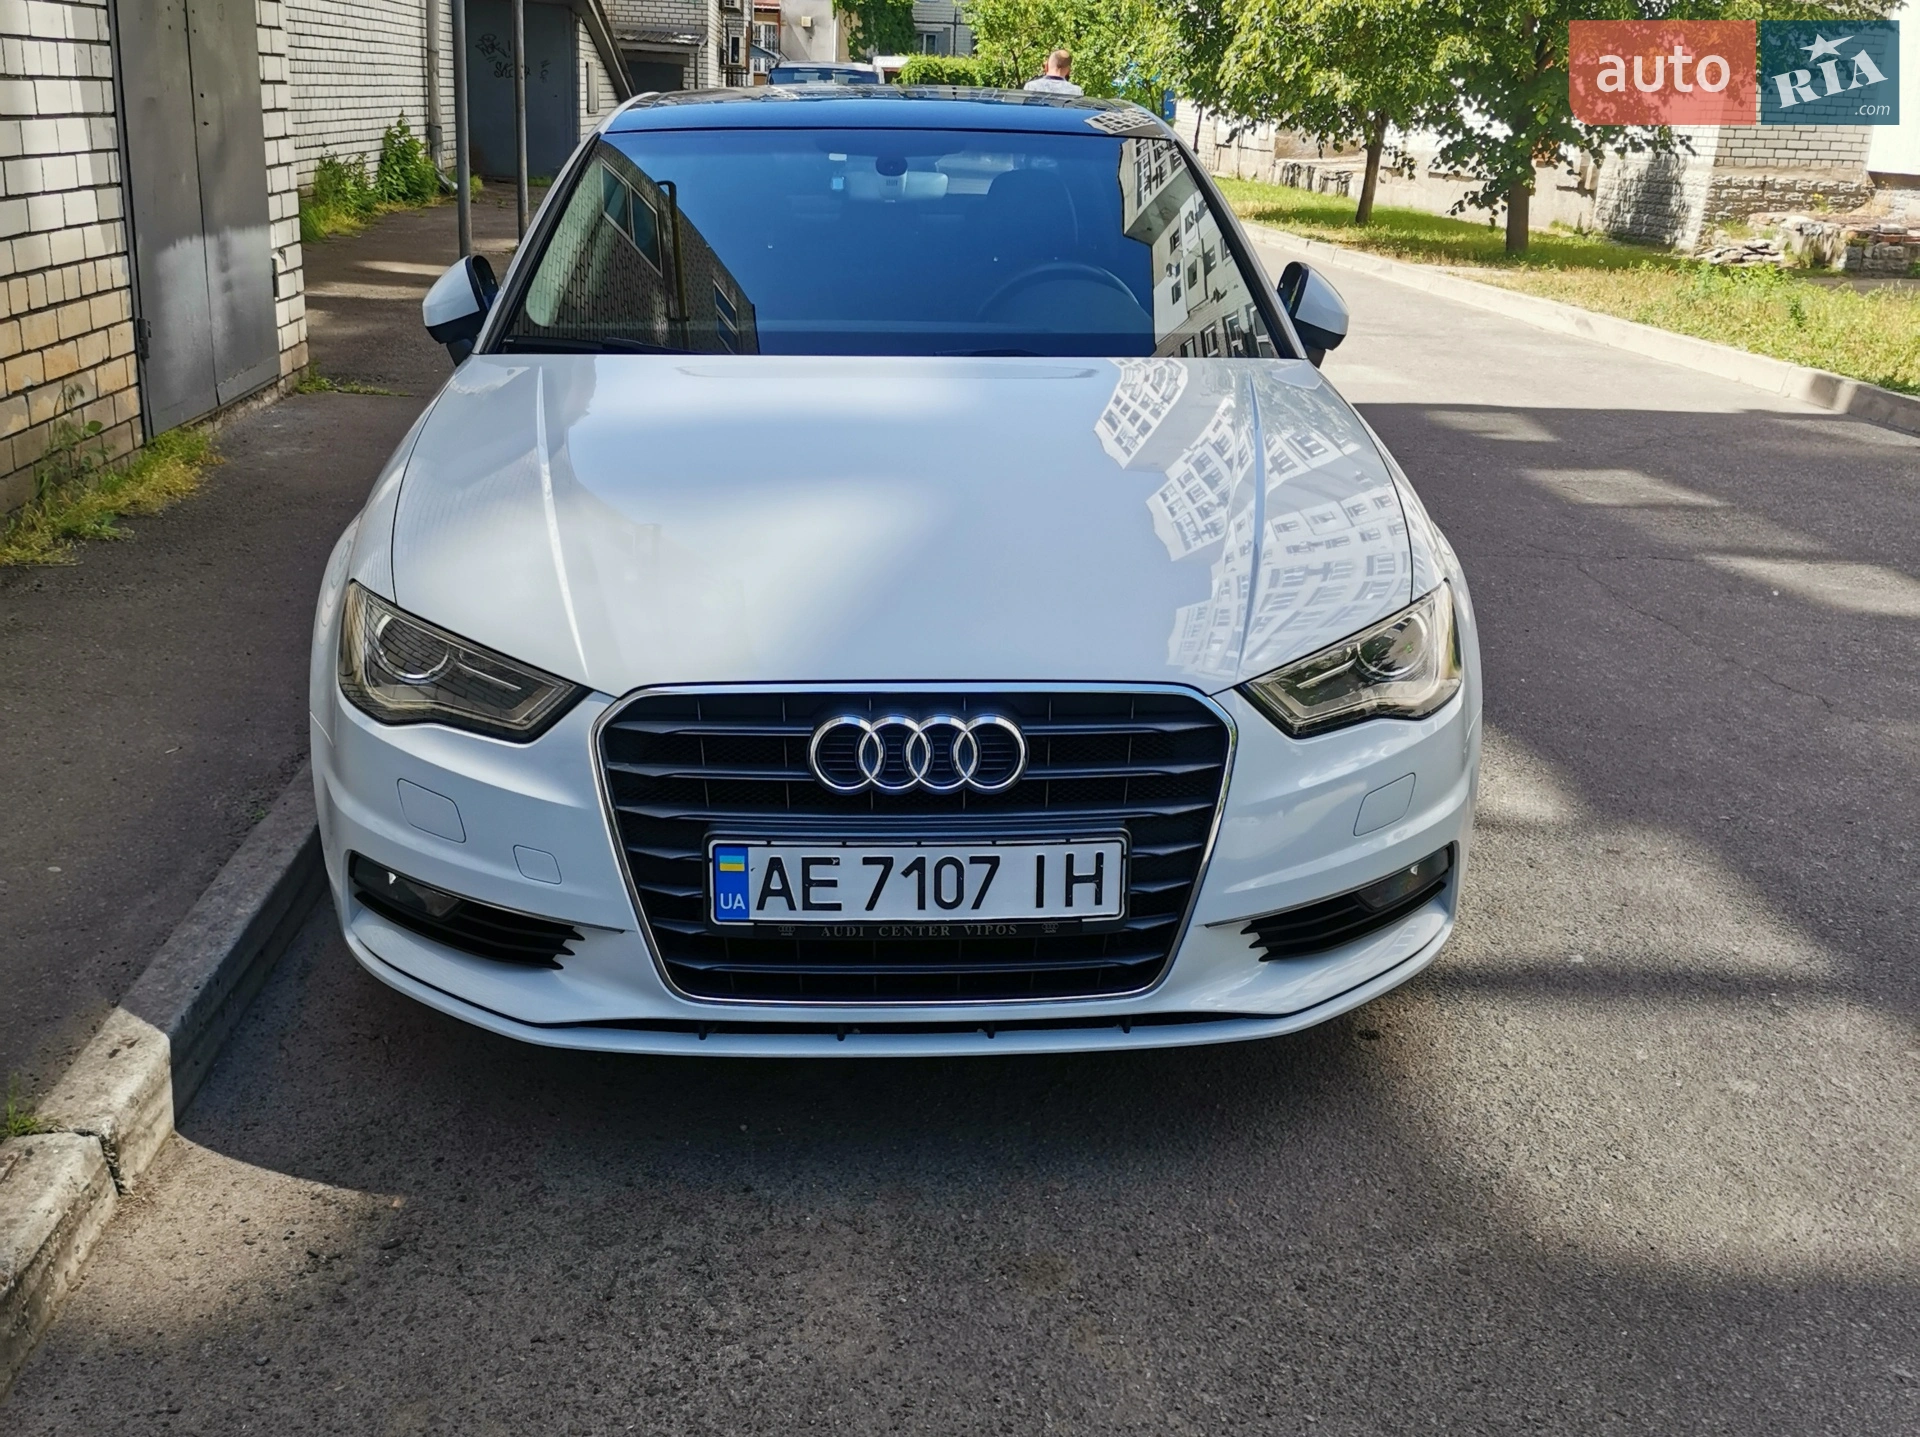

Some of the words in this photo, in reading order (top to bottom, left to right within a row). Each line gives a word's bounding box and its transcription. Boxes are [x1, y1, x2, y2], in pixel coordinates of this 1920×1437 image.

[755, 856, 843, 911] AE
[862, 854, 1001, 911] 7107
[1034, 851, 1105, 909] IH
[719, 892, 746, 910] UA
[821, 925, 865, 937] AUDI
[878, 925, 950, 937] CENTER
[964, 924, 1018, 936] VIPOS
